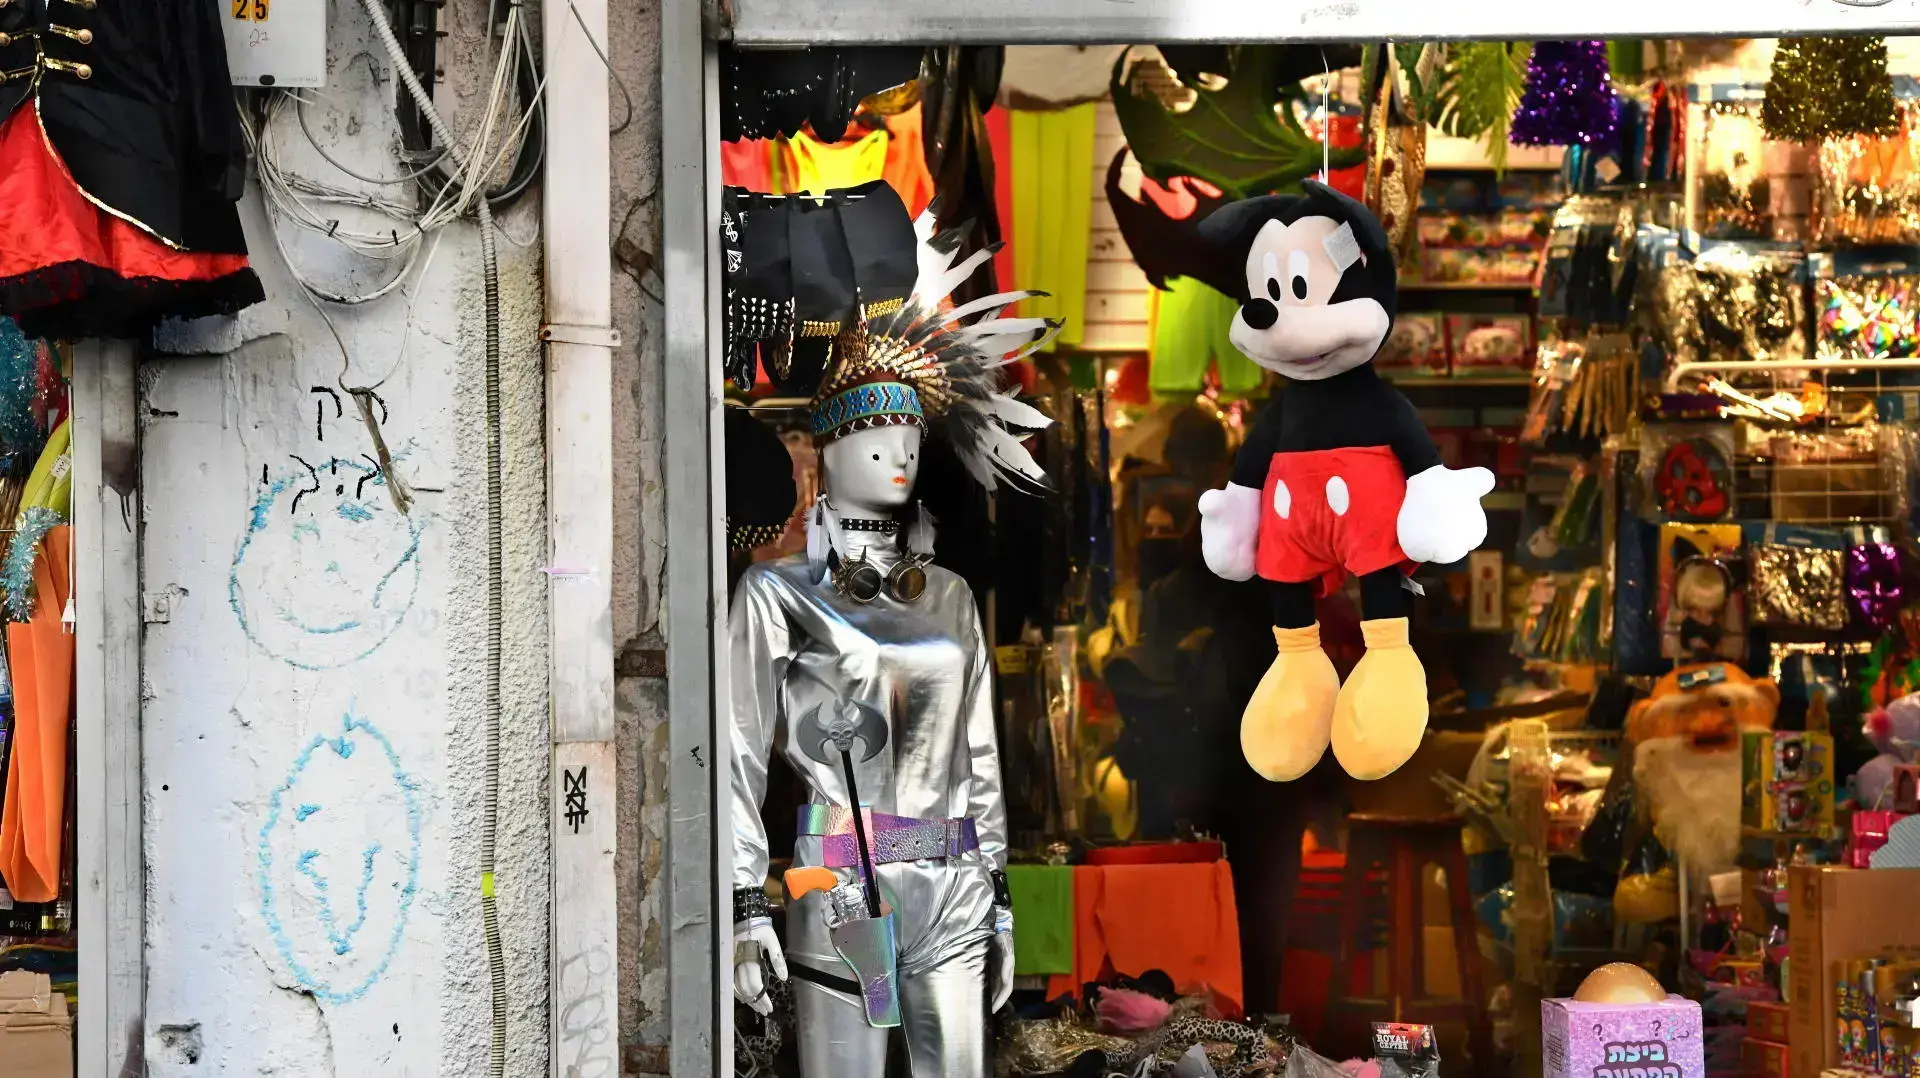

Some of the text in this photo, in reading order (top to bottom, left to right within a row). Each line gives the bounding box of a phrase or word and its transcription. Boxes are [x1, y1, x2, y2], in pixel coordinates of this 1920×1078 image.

[235, 0, 267, 19] 25
[1375, 1034, 1409, 1044] ROYAL
[1606, 1042, 1666, 1064] ביצת
